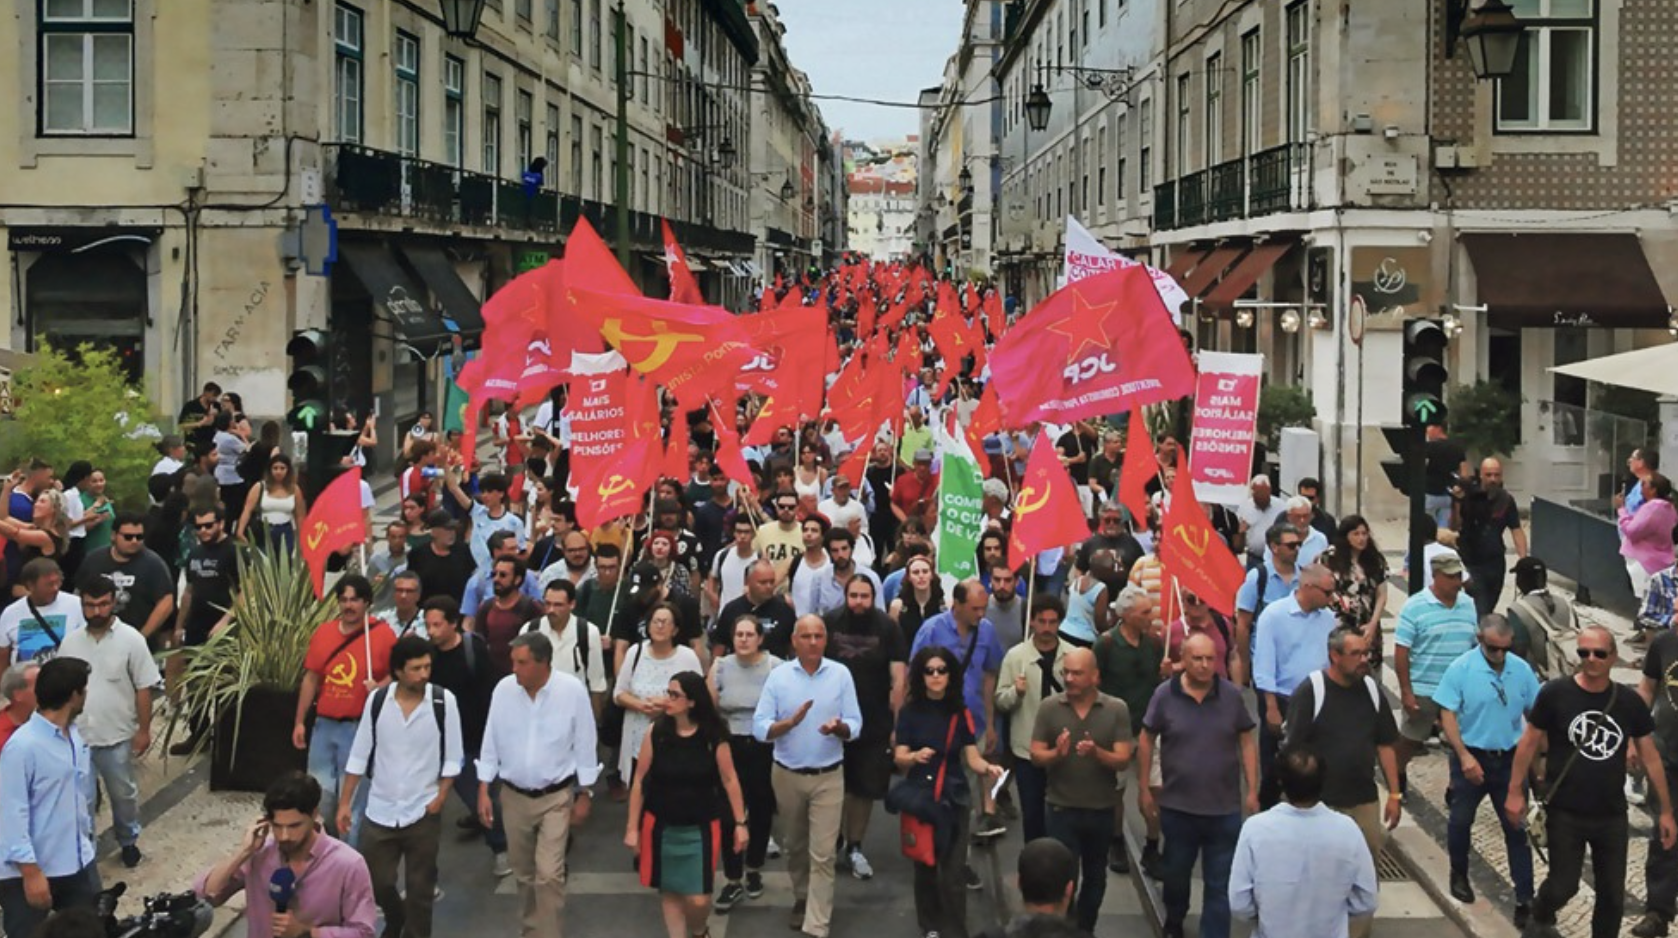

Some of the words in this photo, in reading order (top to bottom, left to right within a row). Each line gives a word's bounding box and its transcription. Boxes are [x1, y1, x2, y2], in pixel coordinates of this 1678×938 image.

[582, 394, 610, 407] MAIS
[946, 508, 958, 519] O
[945, 520, 963, 537] DE
